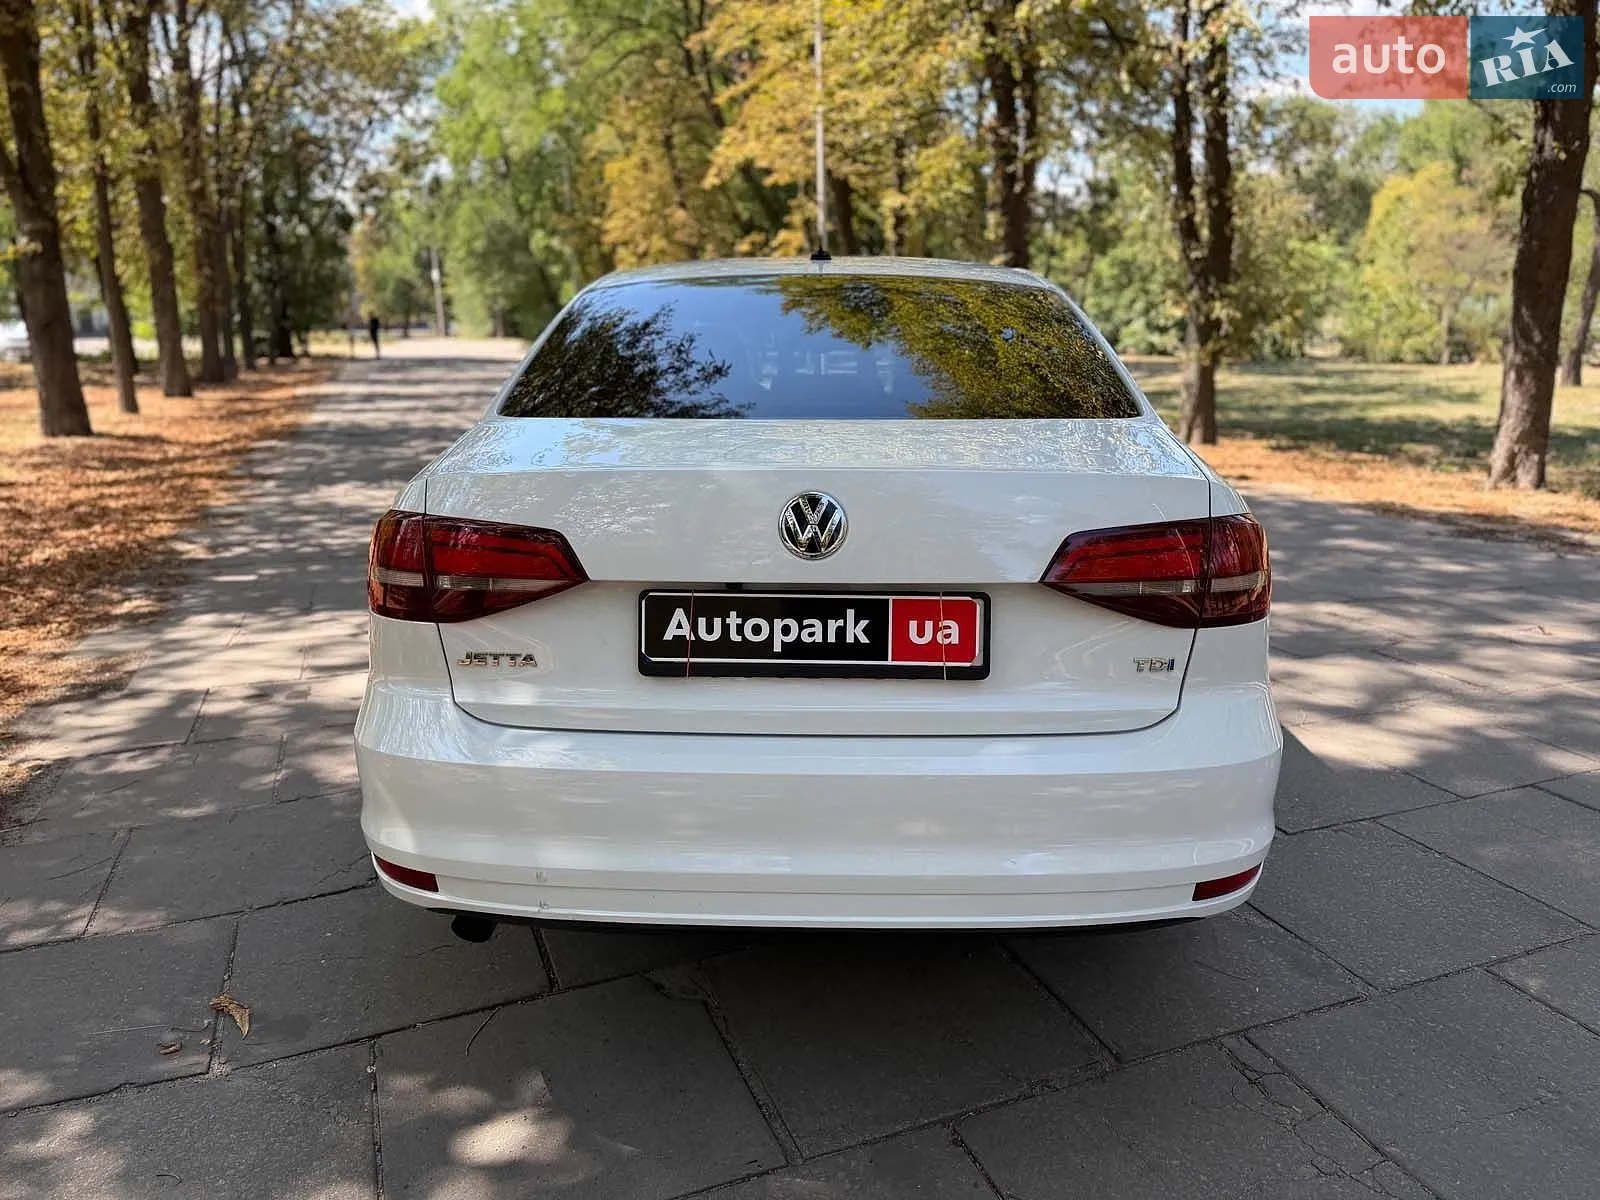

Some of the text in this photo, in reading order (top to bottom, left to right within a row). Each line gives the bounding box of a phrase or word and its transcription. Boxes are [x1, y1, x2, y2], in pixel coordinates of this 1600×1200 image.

[662, 607, 960, 653] Autopark ua
[457, 651, 538, 668] JETTA
[1133, 656, 1175, 673] TDI
